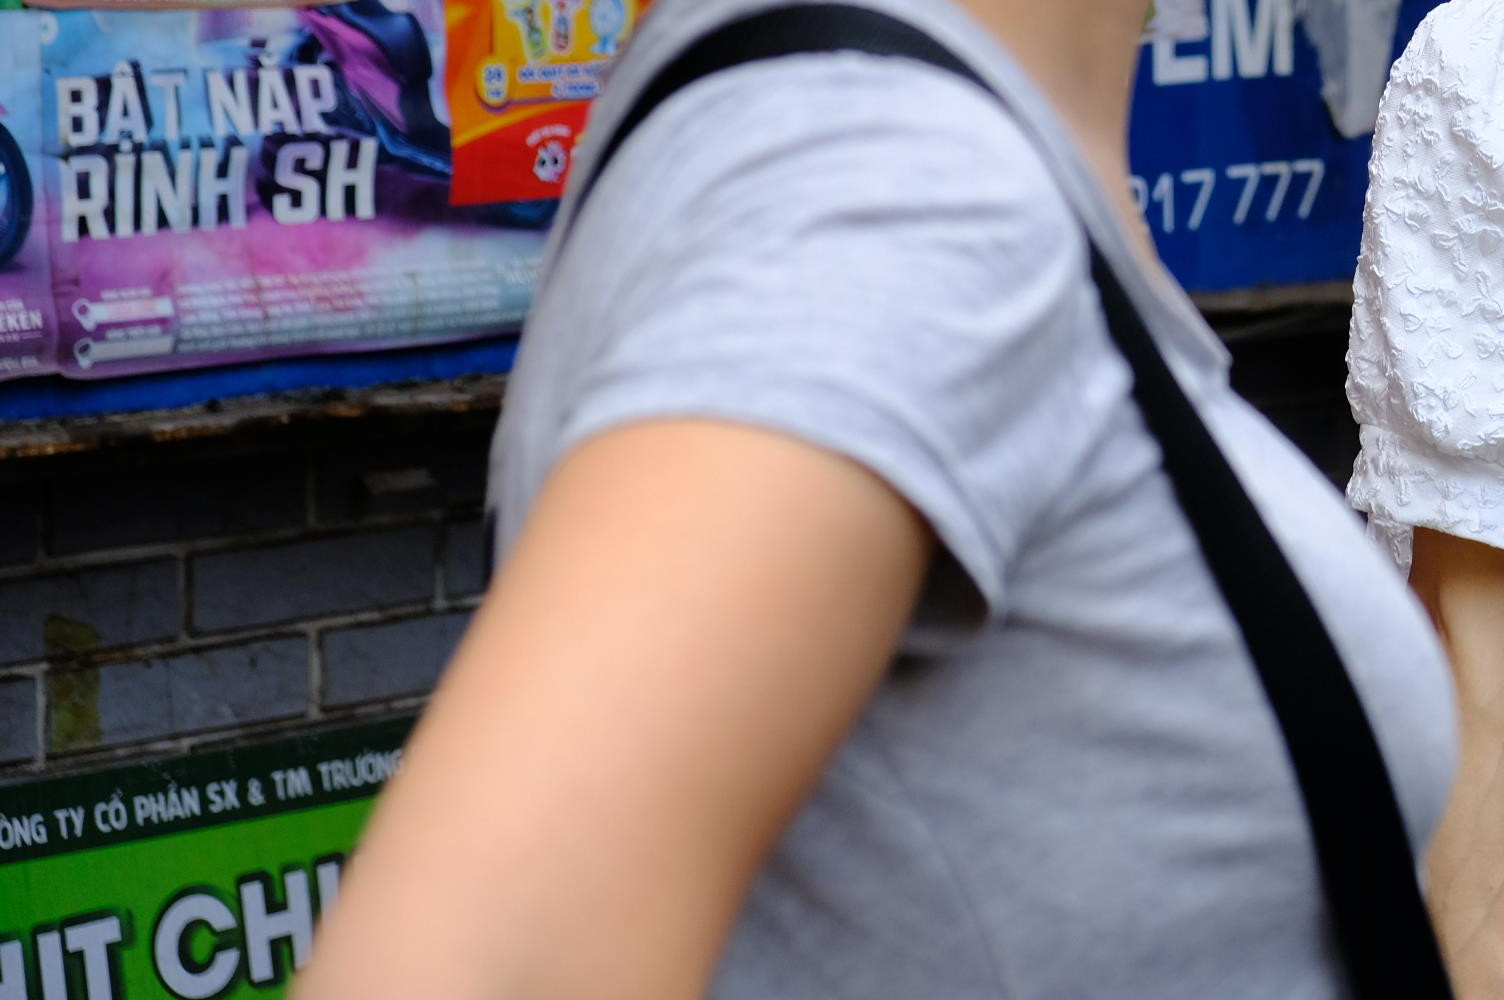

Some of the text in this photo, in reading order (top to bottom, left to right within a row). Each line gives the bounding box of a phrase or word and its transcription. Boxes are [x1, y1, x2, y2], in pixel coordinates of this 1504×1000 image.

[272, 137, 378, 225] SH
[1225, 158, 1325, 225] 777
[53, 805, 85, 840] TY
[206, 778, 240, 813] SX
[247, 777, 265, 806] &
[271, 766, 313, 800] TM
